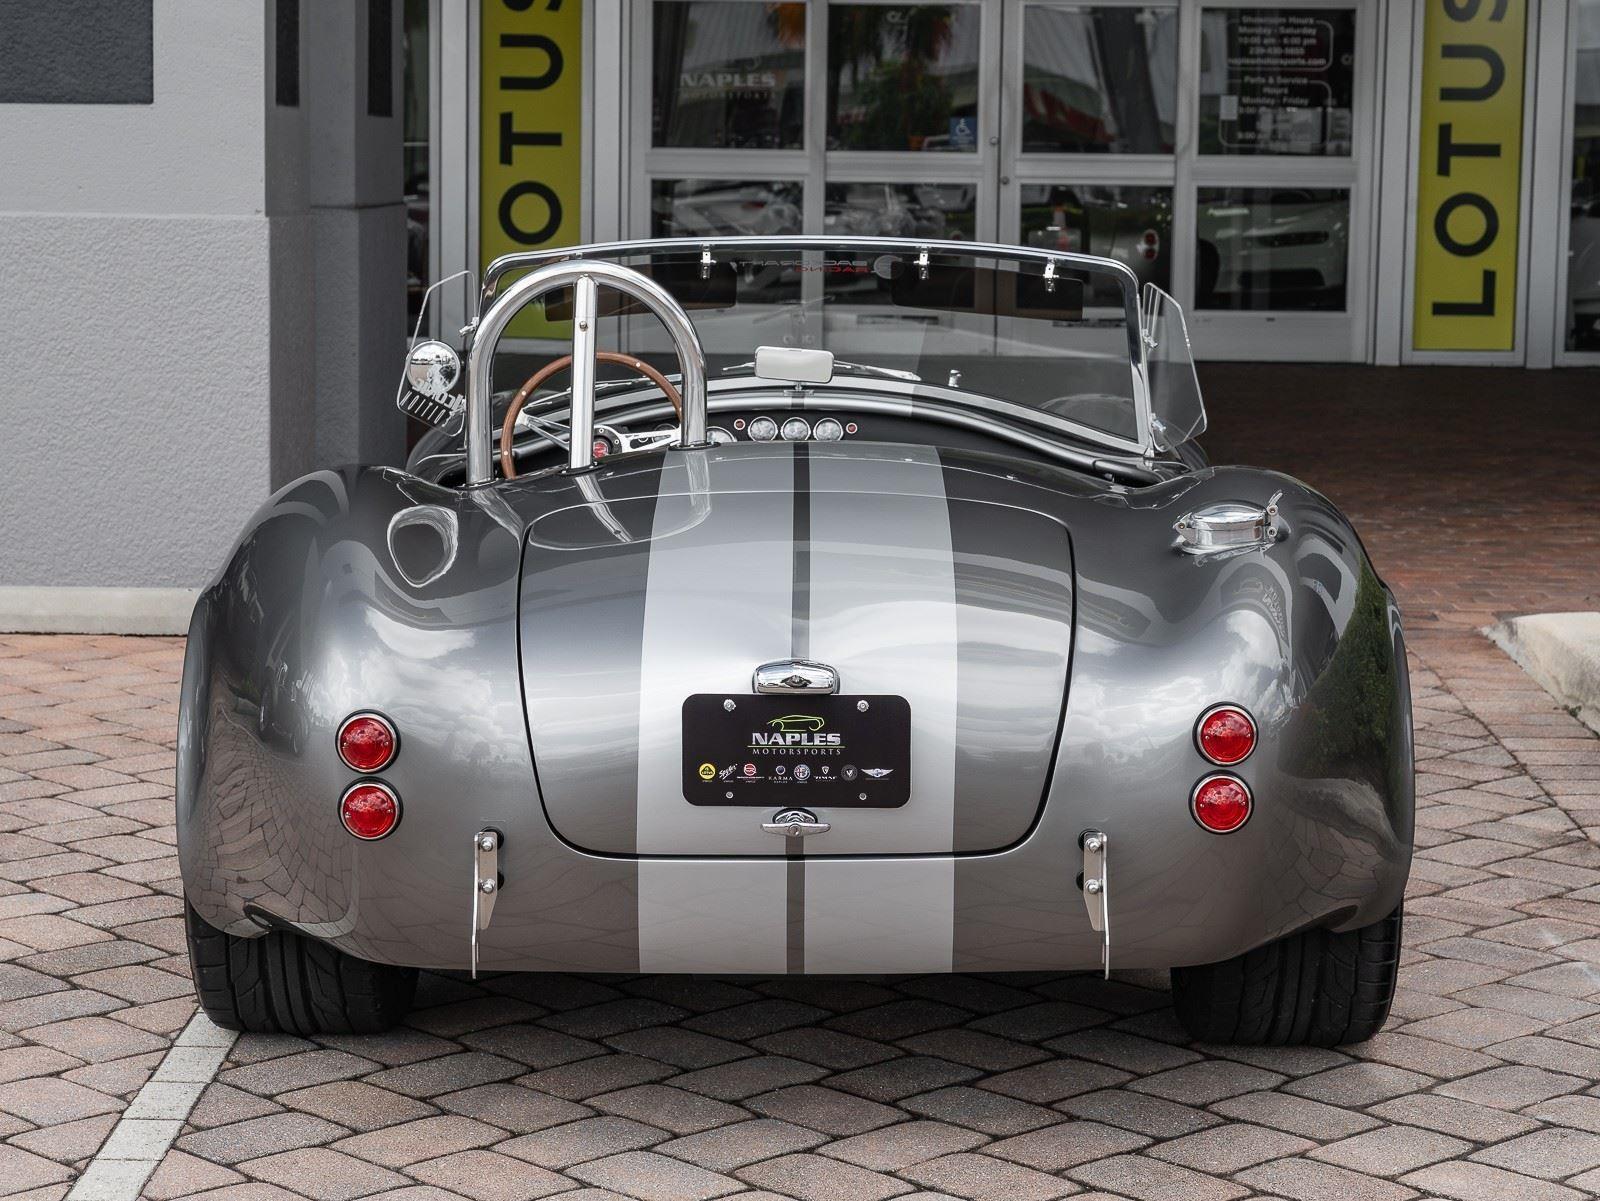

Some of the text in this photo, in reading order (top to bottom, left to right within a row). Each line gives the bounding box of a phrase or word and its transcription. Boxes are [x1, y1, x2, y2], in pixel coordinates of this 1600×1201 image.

[1288, 16, 1314, 24] Hours
[1238, 26, 1272, 35] Monday
[1280, 26, 1317, 36] Saturday
[680, 72, 775, 87] NAPLES
[1282, 96, 1309, 106] Friday
[498, 0, 564, 245] OTU
[751, 732, 841, 746] NAPLES
[752, 748, 841, 756] MOTORSPORTS
